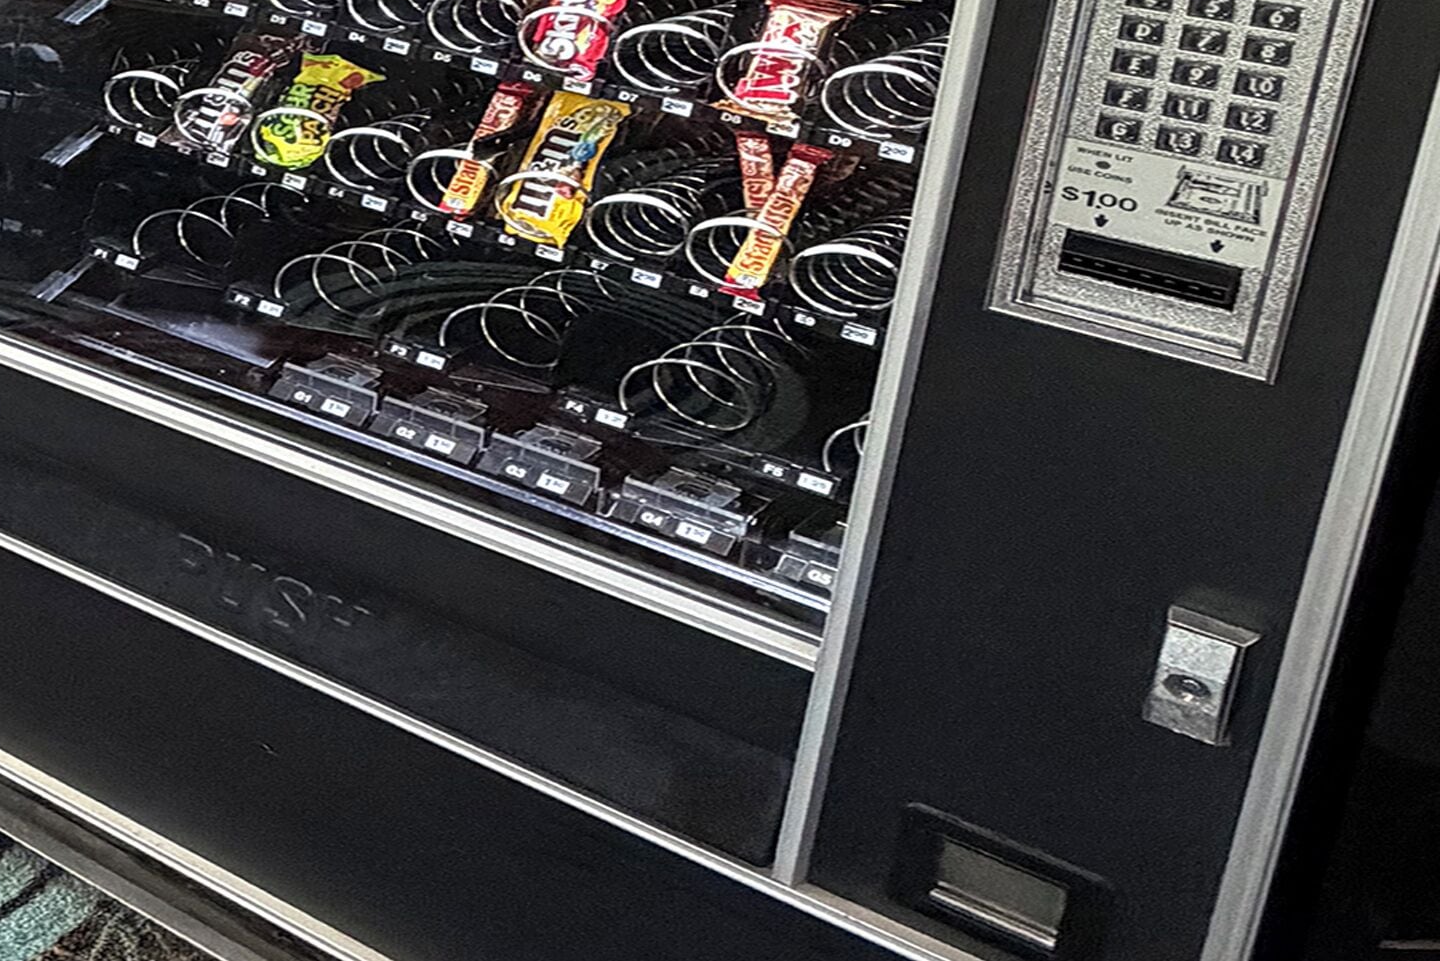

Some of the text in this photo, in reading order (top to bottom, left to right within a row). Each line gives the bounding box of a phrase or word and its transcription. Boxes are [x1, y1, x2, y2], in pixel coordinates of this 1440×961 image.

[1205, 0, 1220, 16] 5
[1268, 10, 1284, 27] 6
[348, 31, 366, 43] D4
[1135, 23, 1152, 41] D
[1200, 33, 1214, 50] 7
[1261, 44, 1276, 62] 8
[1128, 56, 1144, 73] E
[523, 71, 543, 82] D6
[1189, 67, 1205, 84] 9
[1248, 78, 1275, 96] 10
[618, 91, 639, 102] D7
[1118, 89, 1135, 105] F
[1178, 100, 1200, 118] 11
[720, 112, 742, 124] D8
[1241, 111, 1268, 129] 12
[1111, 122, 1128, 140] G
[828, 135, 852, 147] D9
[1168, 132, 1194, 150] 13
[1077, 147, 1134, 163] WHEN LIT
[1230, 145, 1256, 163] 14
[1066, 165, 1134, 185] USE COINS
[1061, 185, 1139, 214] $1.00
[1155, 208, 1268, 238] INSERT BILL FACE
[1164, 218, 1256, 243] UP AS SHOWN
[234, 294, 251, 306] F2
[389, 344, 407, 356] F3
[565, 400, 584, 413] F4
[178, 532, 374, 630] PUSH
